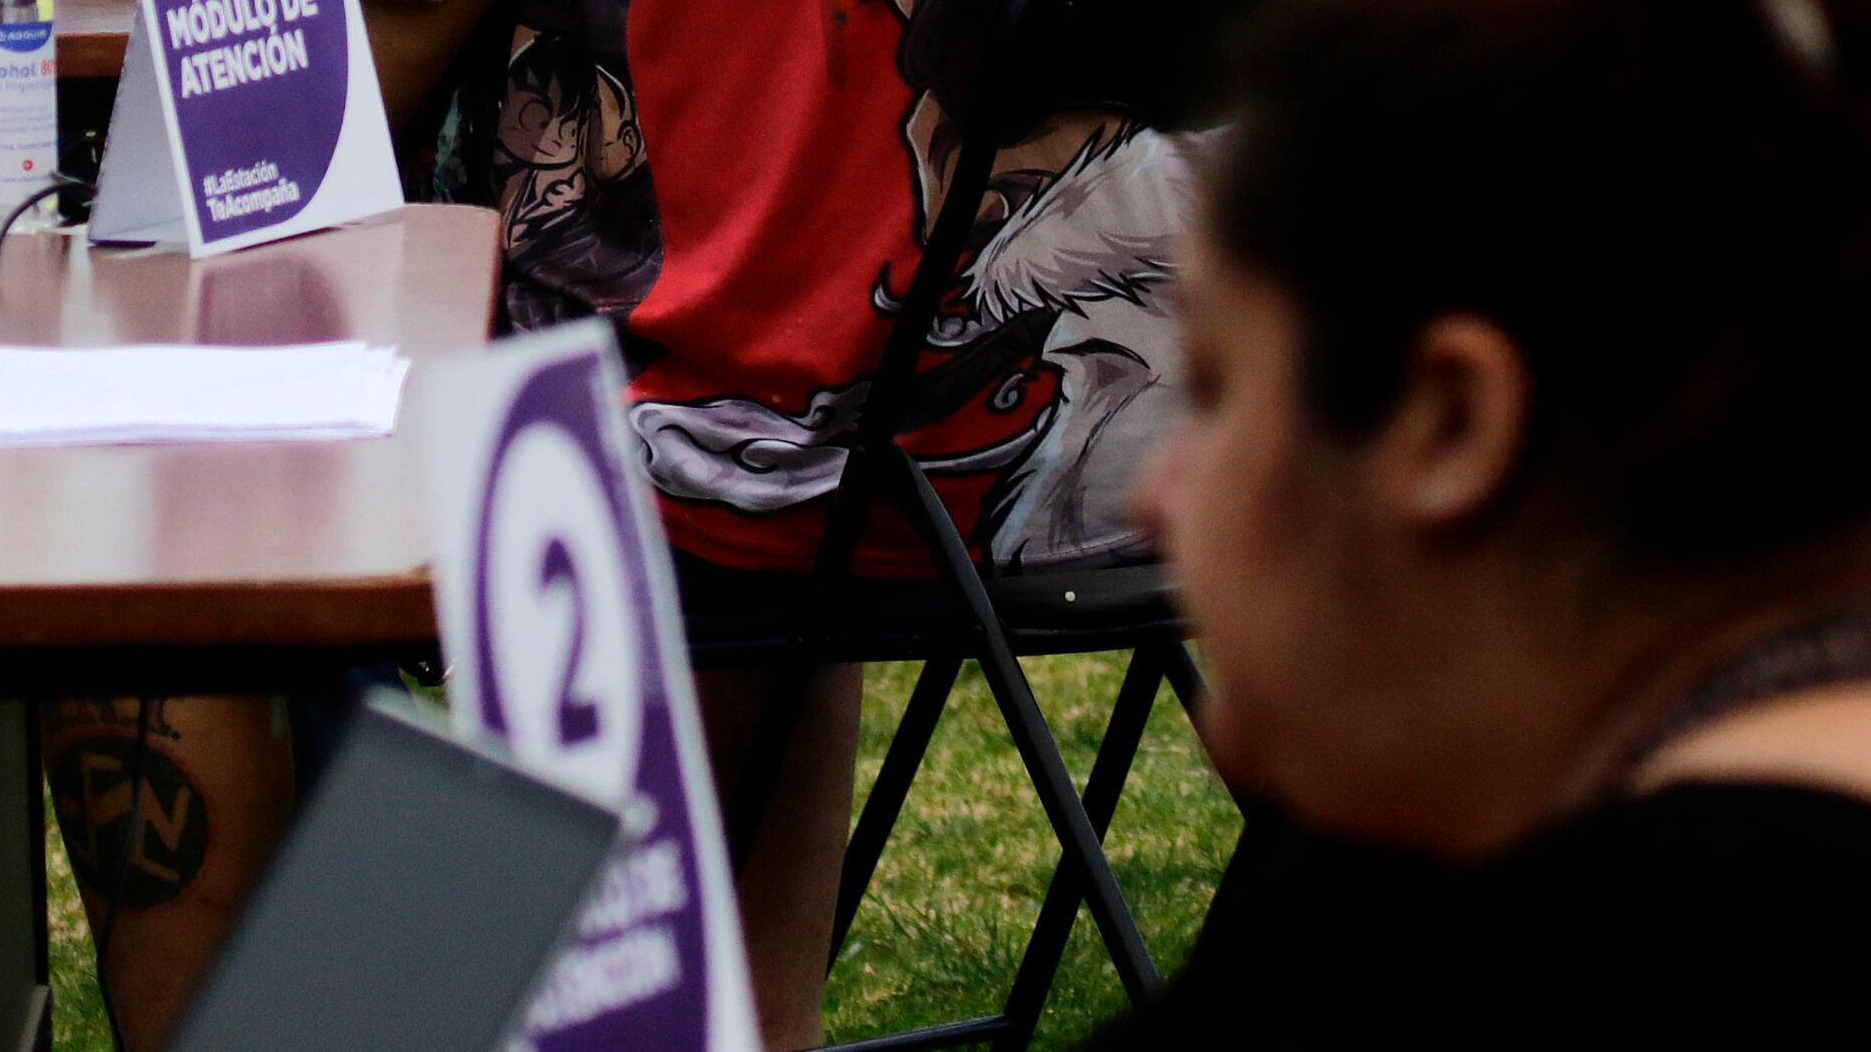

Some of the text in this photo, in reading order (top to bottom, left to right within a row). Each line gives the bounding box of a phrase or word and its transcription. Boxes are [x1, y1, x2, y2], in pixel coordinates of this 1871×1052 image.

[180, 25, 309, 99] ATENCIÓN
[203, 159, 280, 198] #LaEstación
[206, 177, 301, 222] TeAcompaña
[538, 536, 602, 750] 2
